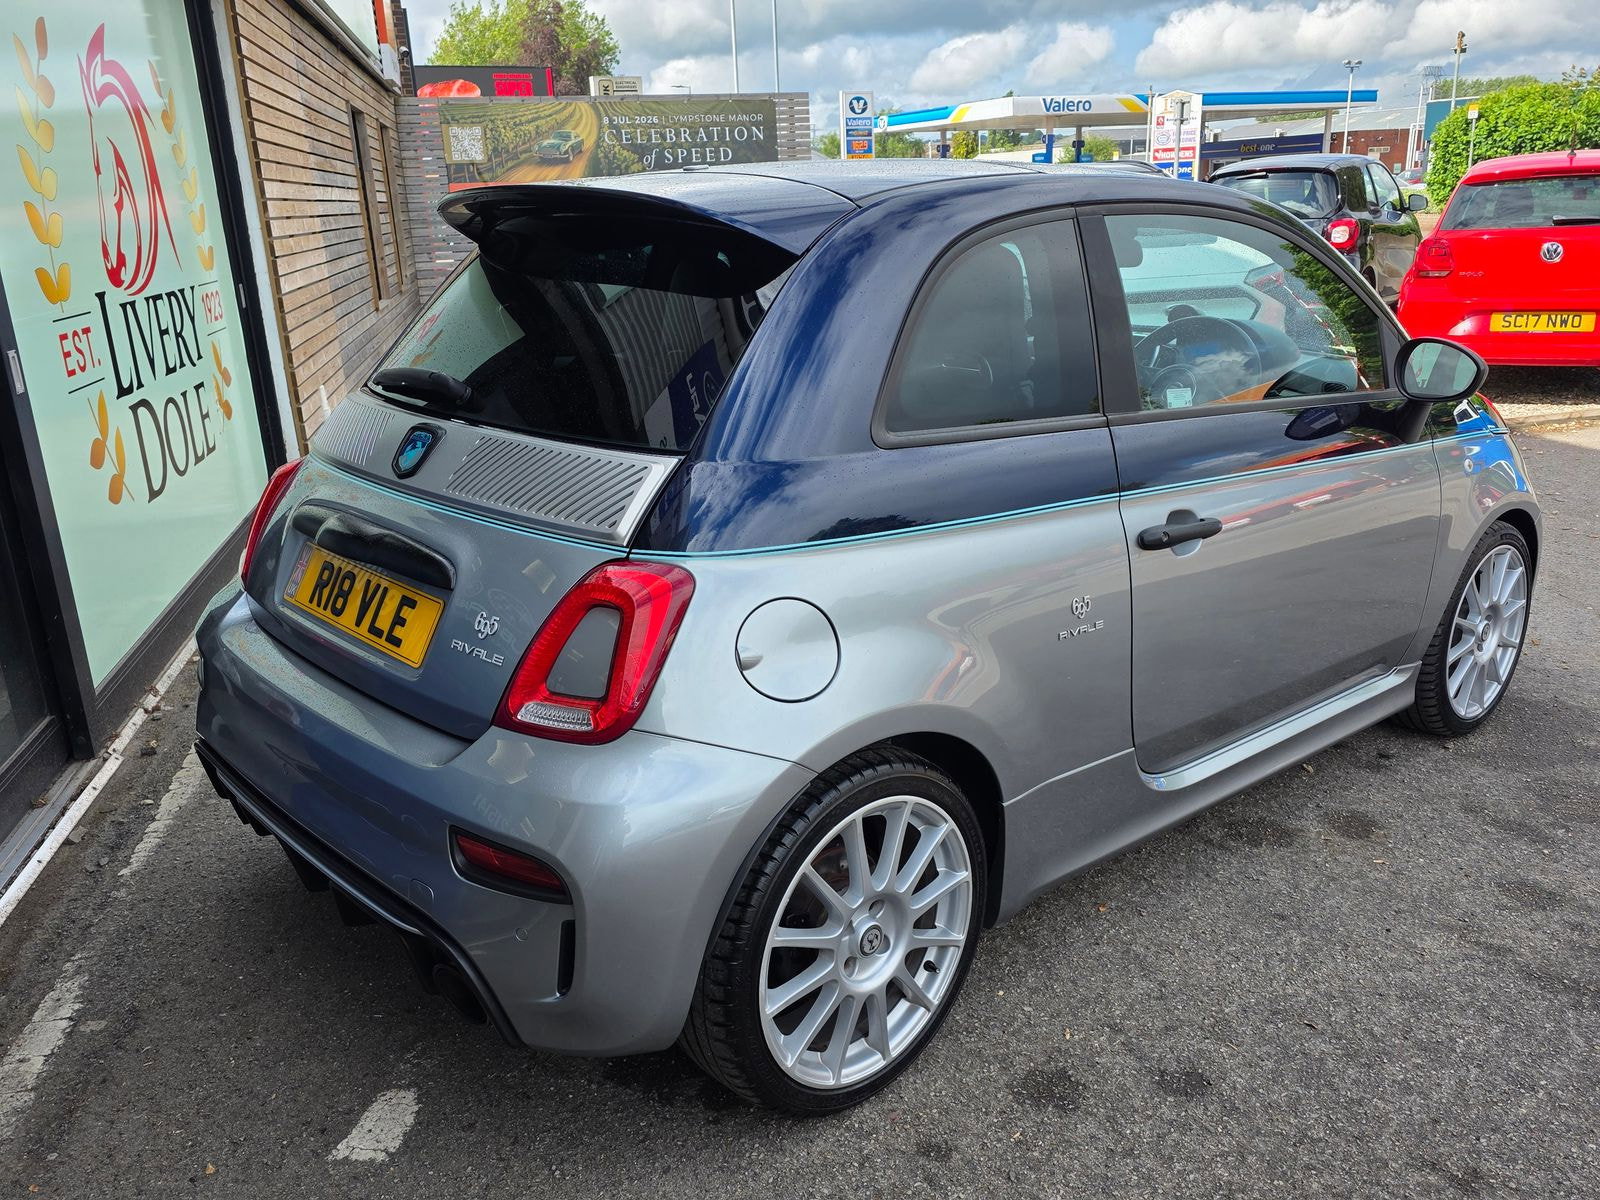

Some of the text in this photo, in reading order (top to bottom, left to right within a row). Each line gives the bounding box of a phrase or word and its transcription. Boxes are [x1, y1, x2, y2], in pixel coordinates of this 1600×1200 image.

[1042, 97, 1092, 113] Valero
[603, 113, 764, 125] 8 JUL 2026 LYMPSTONE MANOR
[847, 118, 871, 126] Valero
[604, 126, 764, 145] CELEBRATION
[643, 147, 733, 170] of SPEED
[201, 290, 224, 324] 1923
[1502, 314, 1582, 328] SC17 NWO
[58, 326, 101, 378] EST.
[94, 285, 203, 400] LIVERY
[129, 381, 216, 504] DOLE
[308, 560, 418, 648] R18 VLE
[474, 611, 500, 639] 695
[1057, 620, 1104, 641] RIVALE
[450, 639, 505, 666] RIVALE
